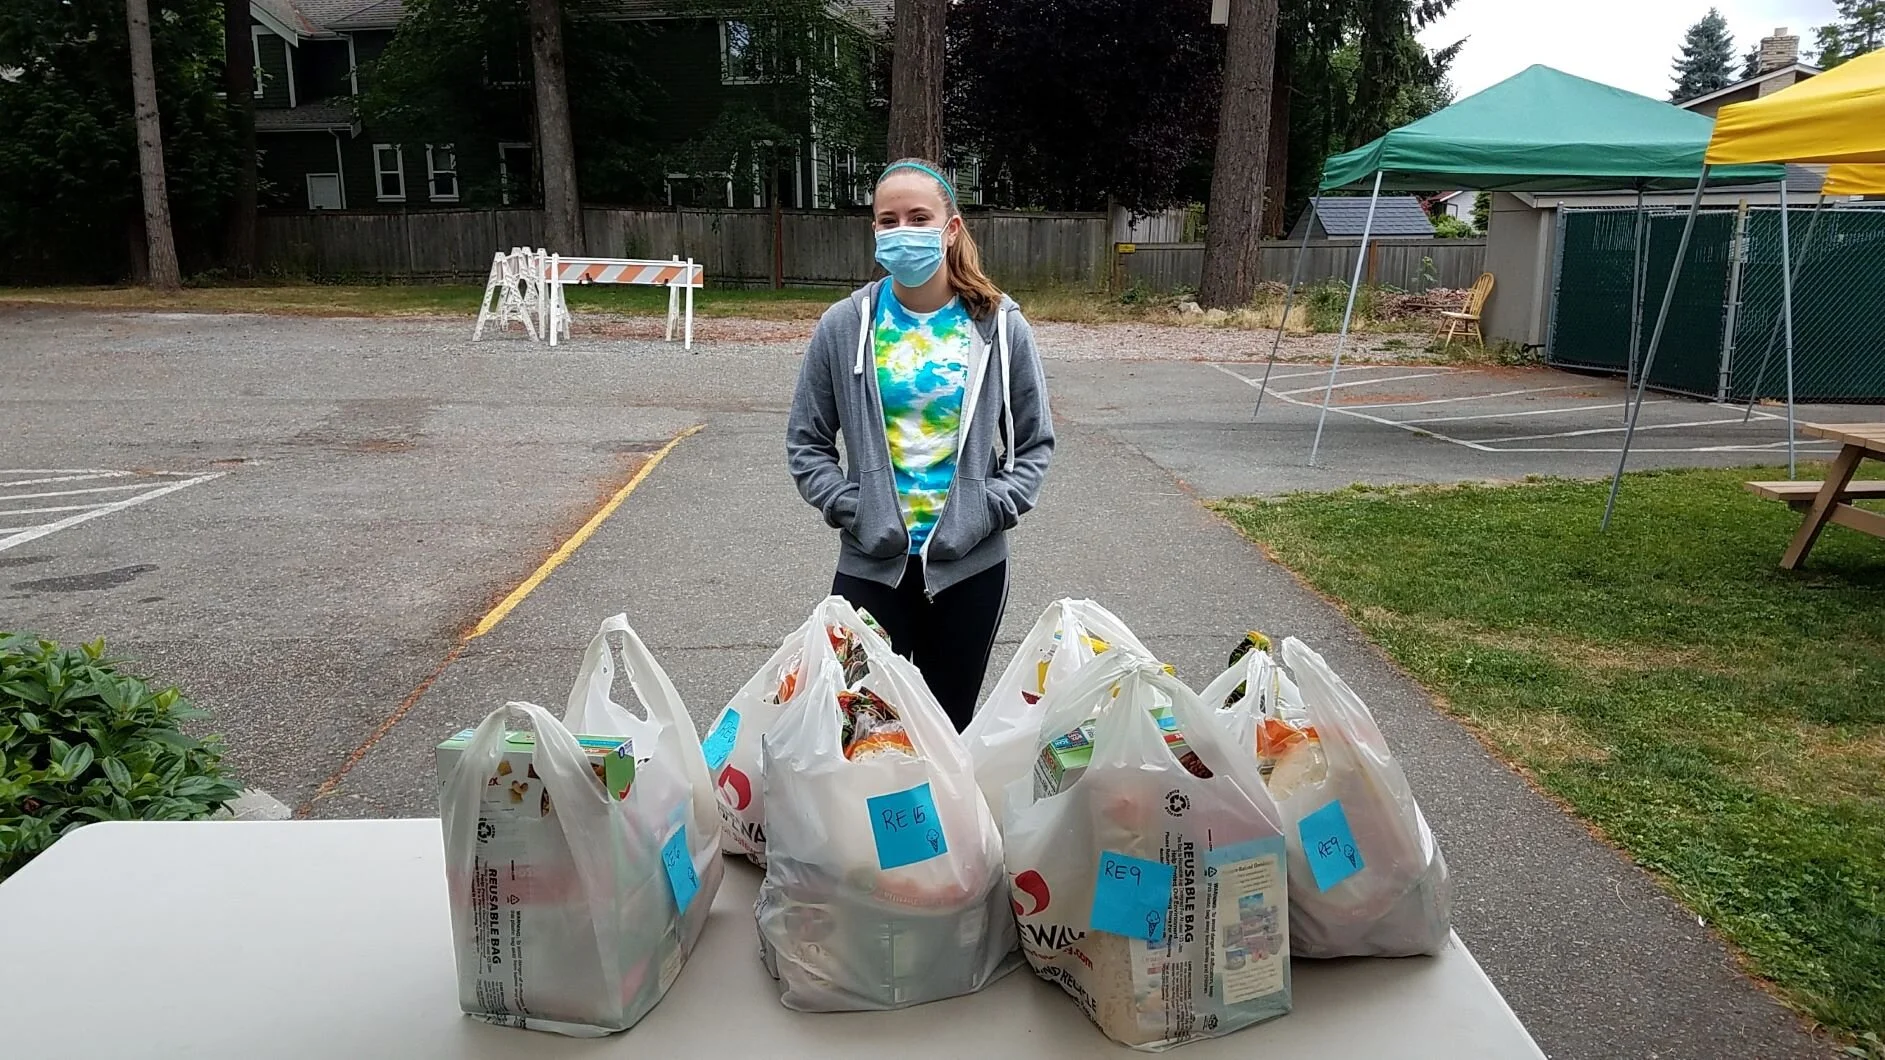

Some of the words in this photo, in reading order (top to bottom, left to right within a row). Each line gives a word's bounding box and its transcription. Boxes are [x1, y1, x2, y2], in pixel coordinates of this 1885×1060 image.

[881, 808, 908, 833] RE
[1317, 836, 1341, 859] RE9
[1105, 860, 1141, 886] RE9
[1184, 841, 1195, 912] REUSABLE
[488, 868, 499, 936] REUSABLE
[1184, 914, 1195, 943] BAG
[490, 937, 502, 964] BAG
